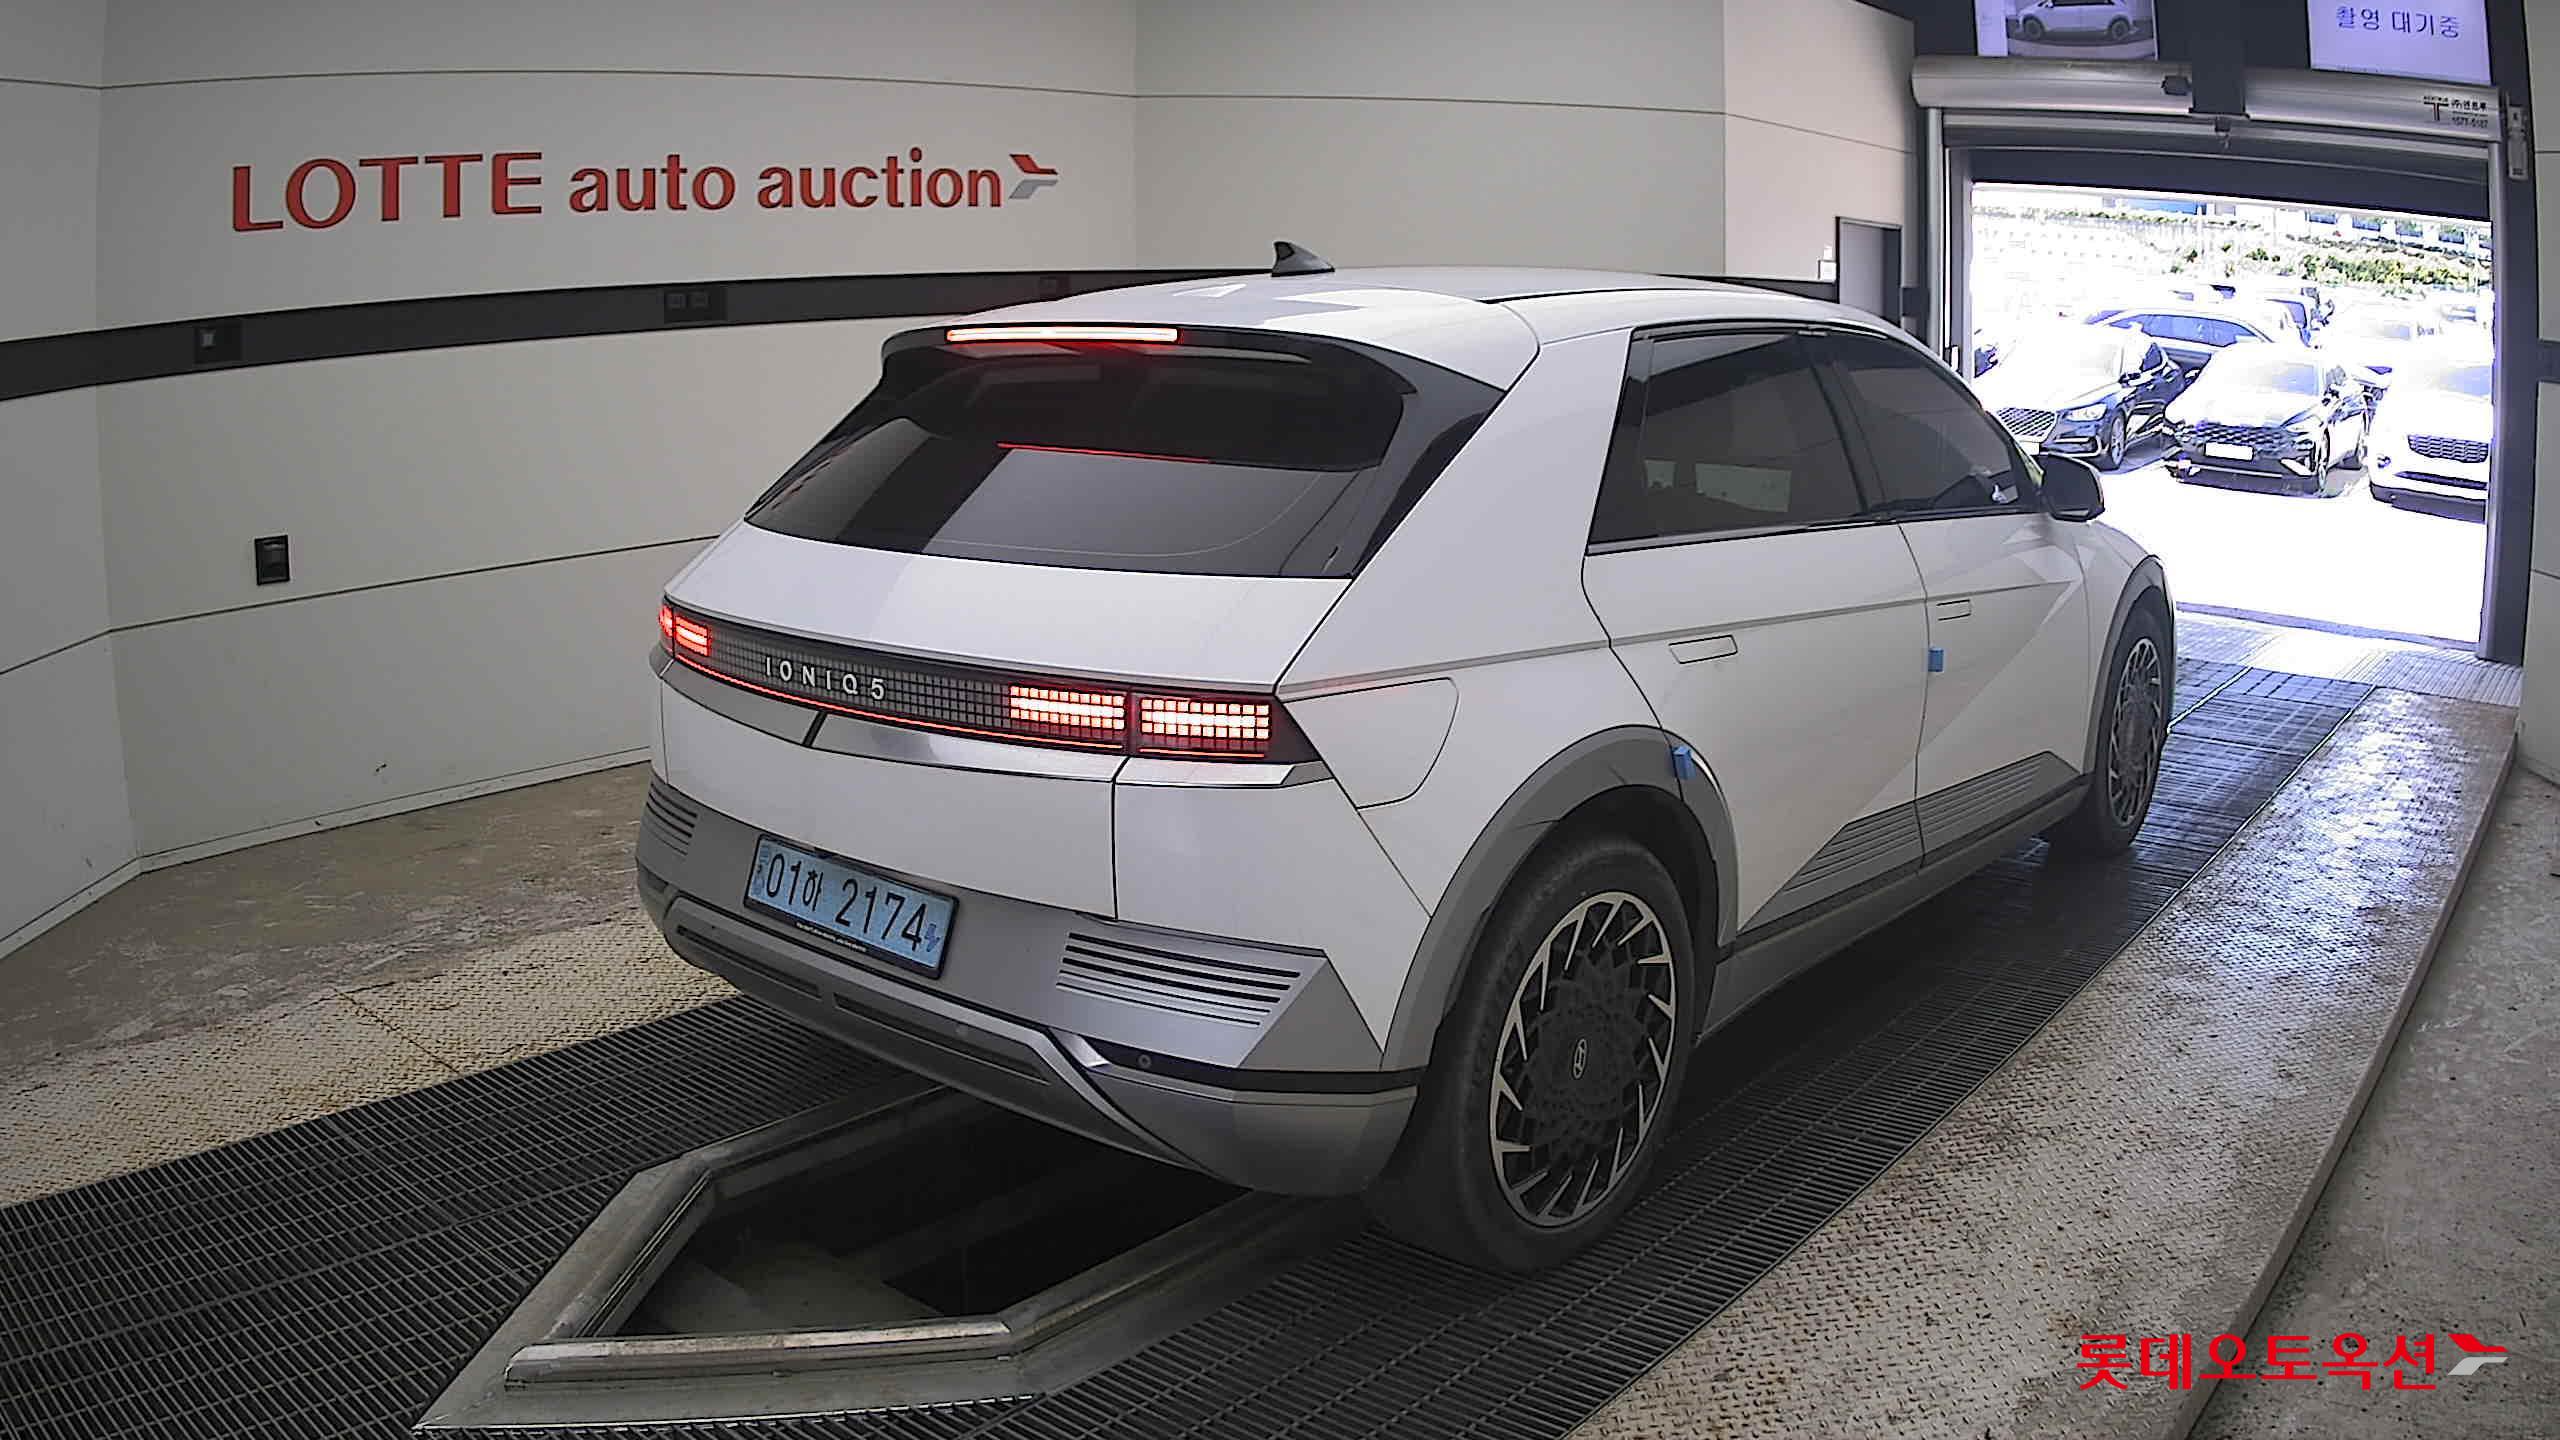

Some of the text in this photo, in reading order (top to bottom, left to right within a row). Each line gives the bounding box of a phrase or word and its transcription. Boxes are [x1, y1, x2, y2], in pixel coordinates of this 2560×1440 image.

[2337, 6, 2459, 39] 촬영 대기중
[233, 147, 1005, 232] LOTTE auto auction
[765, 656, 886, 701] IONIQ 5
[765, 853, 824, 912] 01하
[834, 878, 927, 951] 2174
